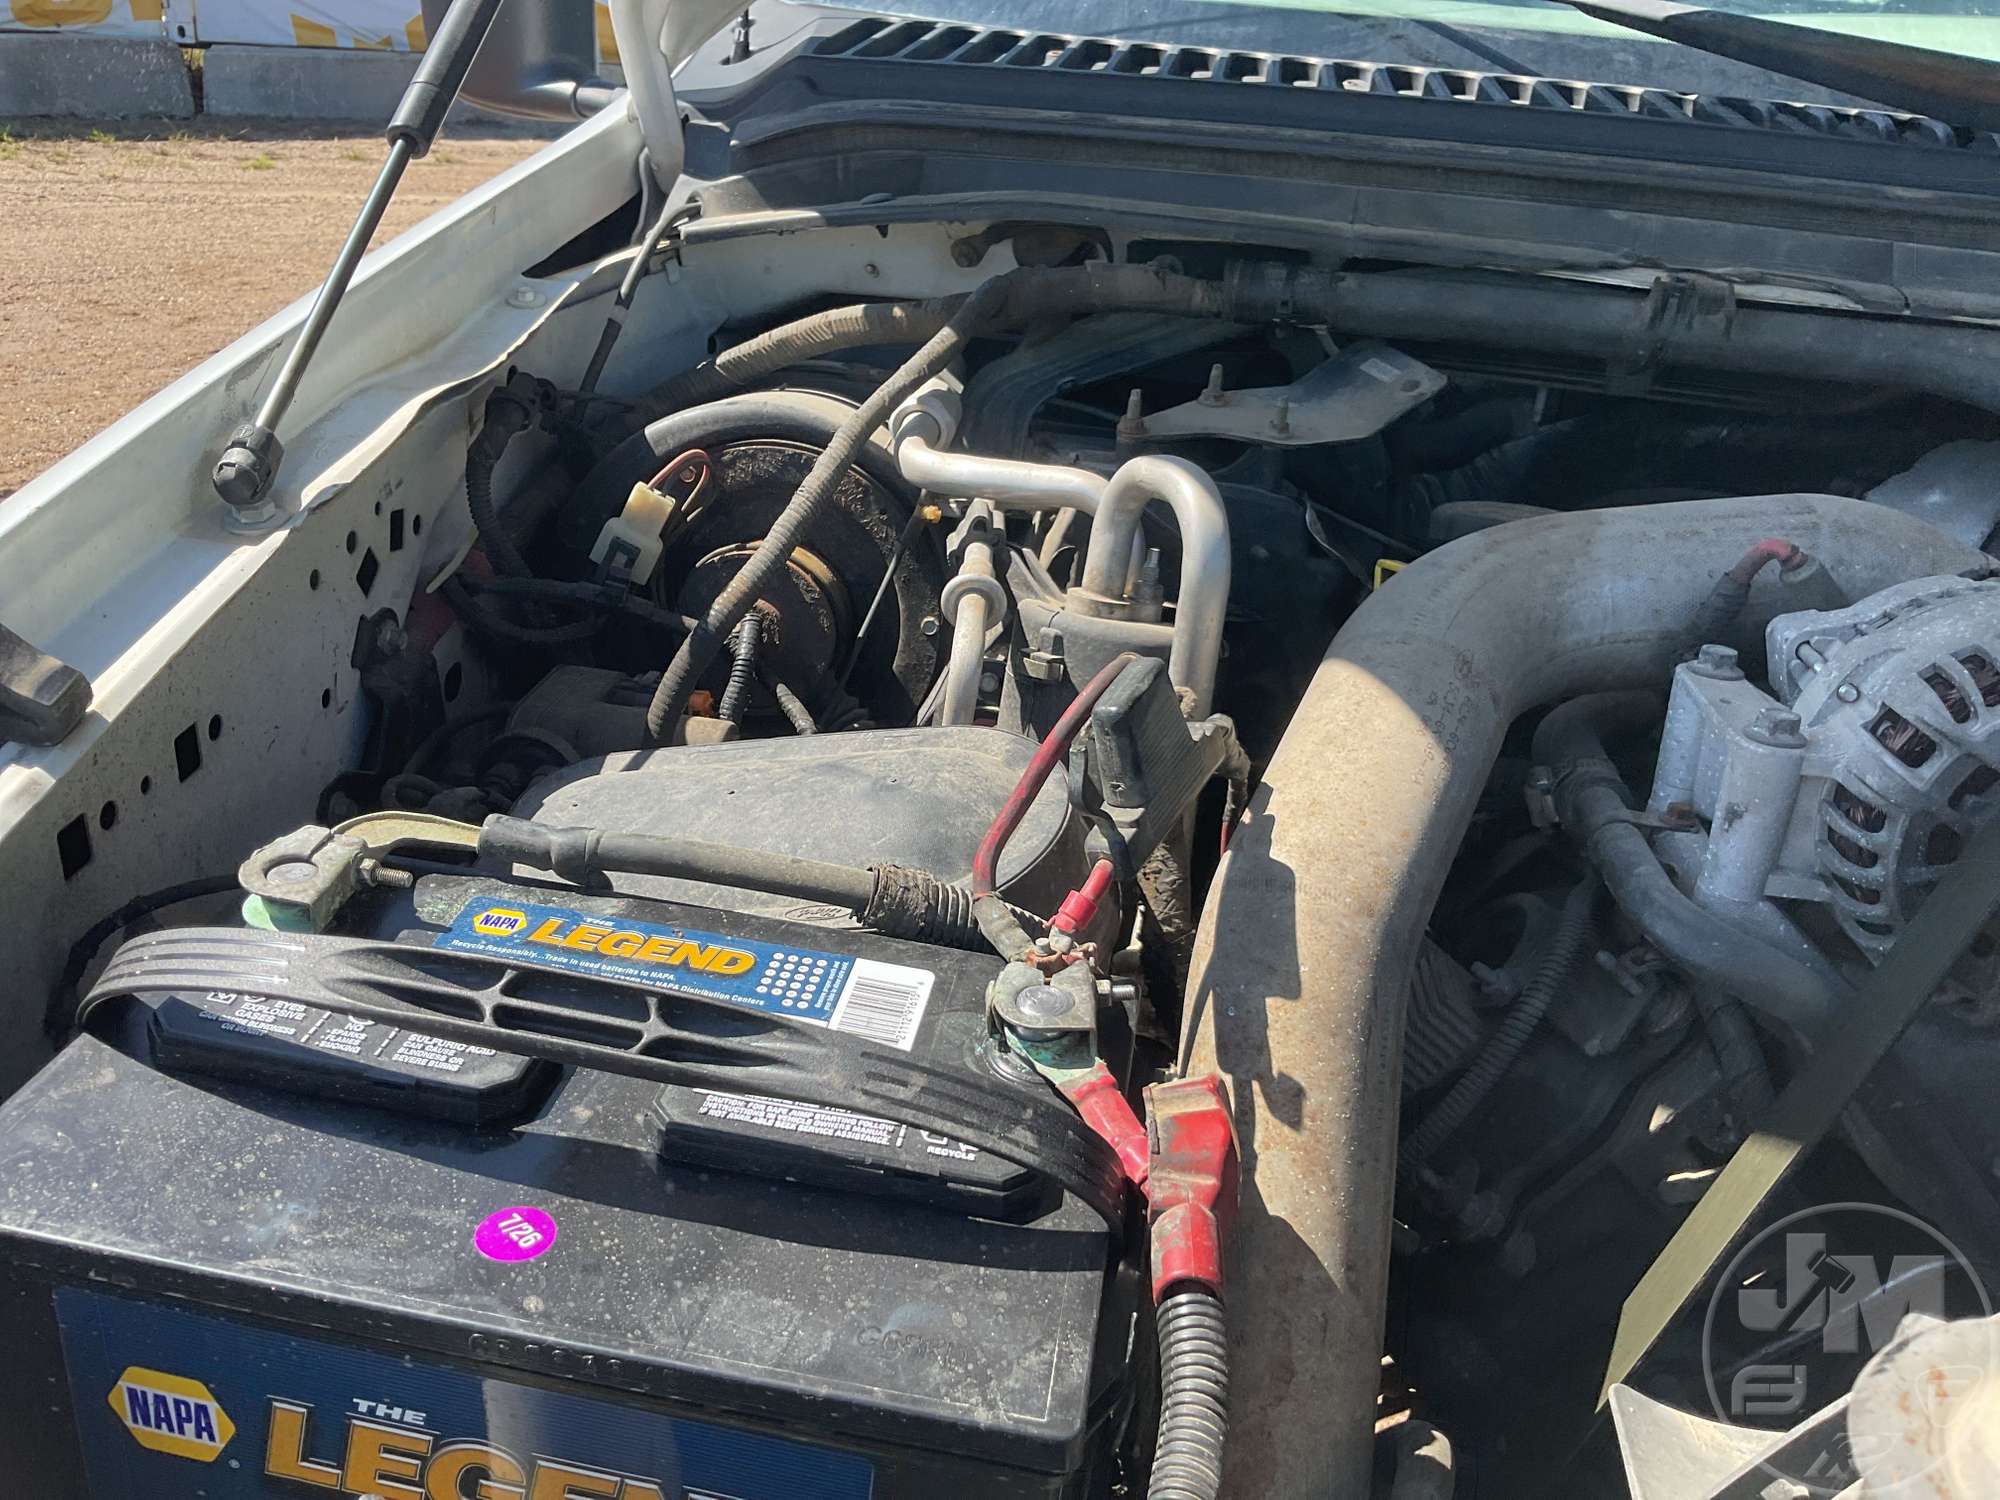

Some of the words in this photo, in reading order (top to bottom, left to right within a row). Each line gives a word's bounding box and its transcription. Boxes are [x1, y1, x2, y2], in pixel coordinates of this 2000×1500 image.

[478, 913, 521, 930] NAPA
[452, 939, 484, 950] Recycle
[579, 960, 601, 969] used
[527, 916, 759, 976] LEGEND
[655, 980, 680, 990] NAPA
[680, 985, 731, 1000] Distribution
[731, 994, 766, 1006] Centers
[240, 1002, 307, 1020] EXPLOSIVE
[275, 1000, 307, 1012] EYES
[235, 1009, 276, 1023] GASES
[344, 1022, 366, 1032] NO
[402, 1040, 424, 1050] CAN
[425, 1045, 457, 1056] CAUSE
[408, 1033, 467, 1051] SULFURIC
[465, 1045, 497, 1056] ACID
[392, 1053, 428, 1066] SEVERE
[427, 1060, 461, 1072] BURNS
[397, 1047, 447, 1062] BLINDNESS
[448, 1056, 465, 1065] OR
[926, 1145, 977, 1161] RECYCLE
[498, 1212, 543, 1248] 7/26
[126, 1385, 217, 1443] NAPA
[352, 1397, 427, 1426] THE
